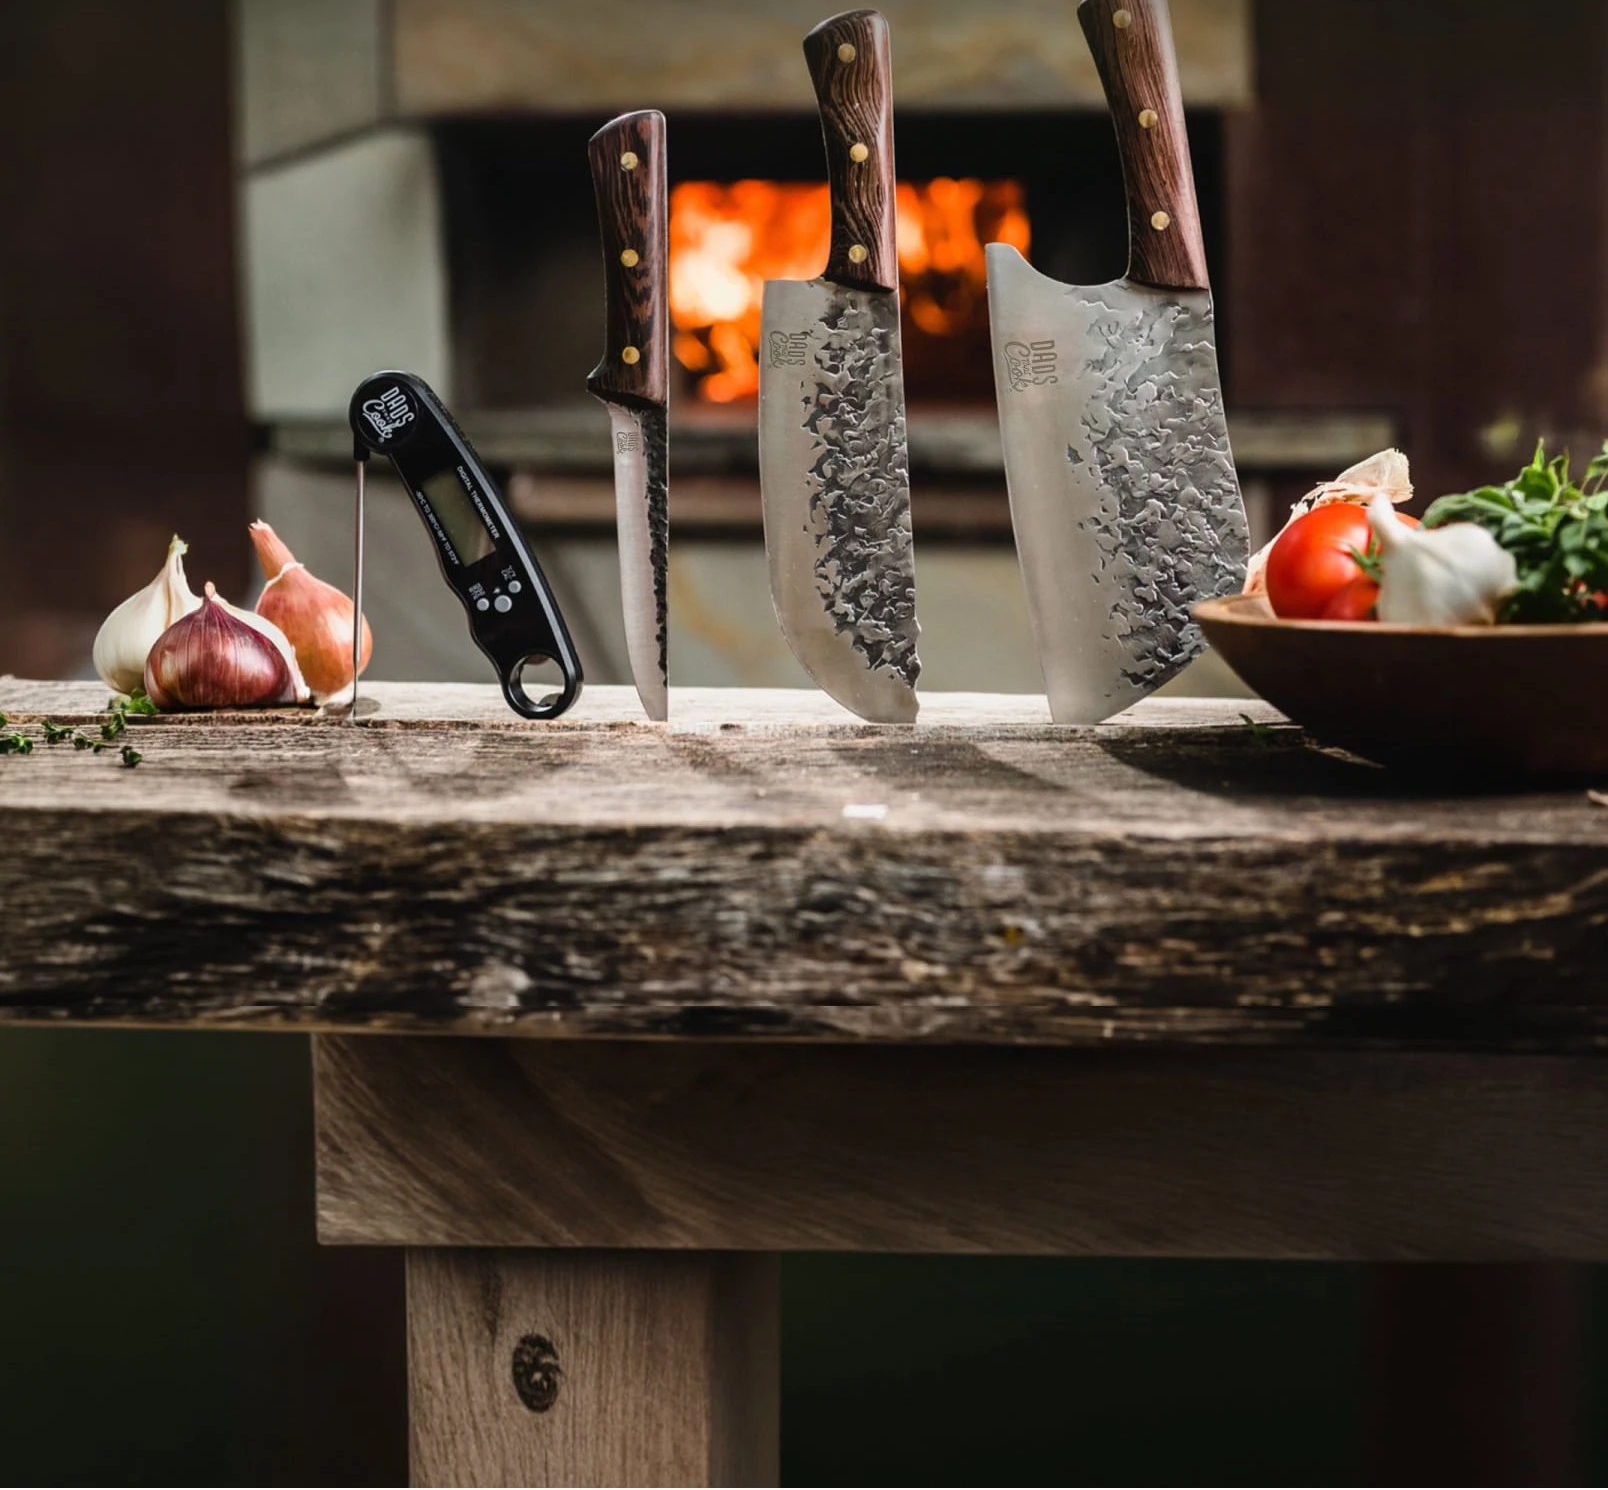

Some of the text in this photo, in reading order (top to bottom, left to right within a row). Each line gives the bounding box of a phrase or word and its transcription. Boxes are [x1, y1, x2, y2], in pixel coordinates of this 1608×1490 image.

[768, 330, 793, 370] Cook
[788, 332, 808, 367] DADS
[1003, 341, 1034, 393] Cook
[1030, 339, 1059, 386] DADS
[362, 399, 402, 439] Cook
[380, 386, 415, 429] DADS
[456, 465, 500, 539] DIGITAL THERMOMETER
